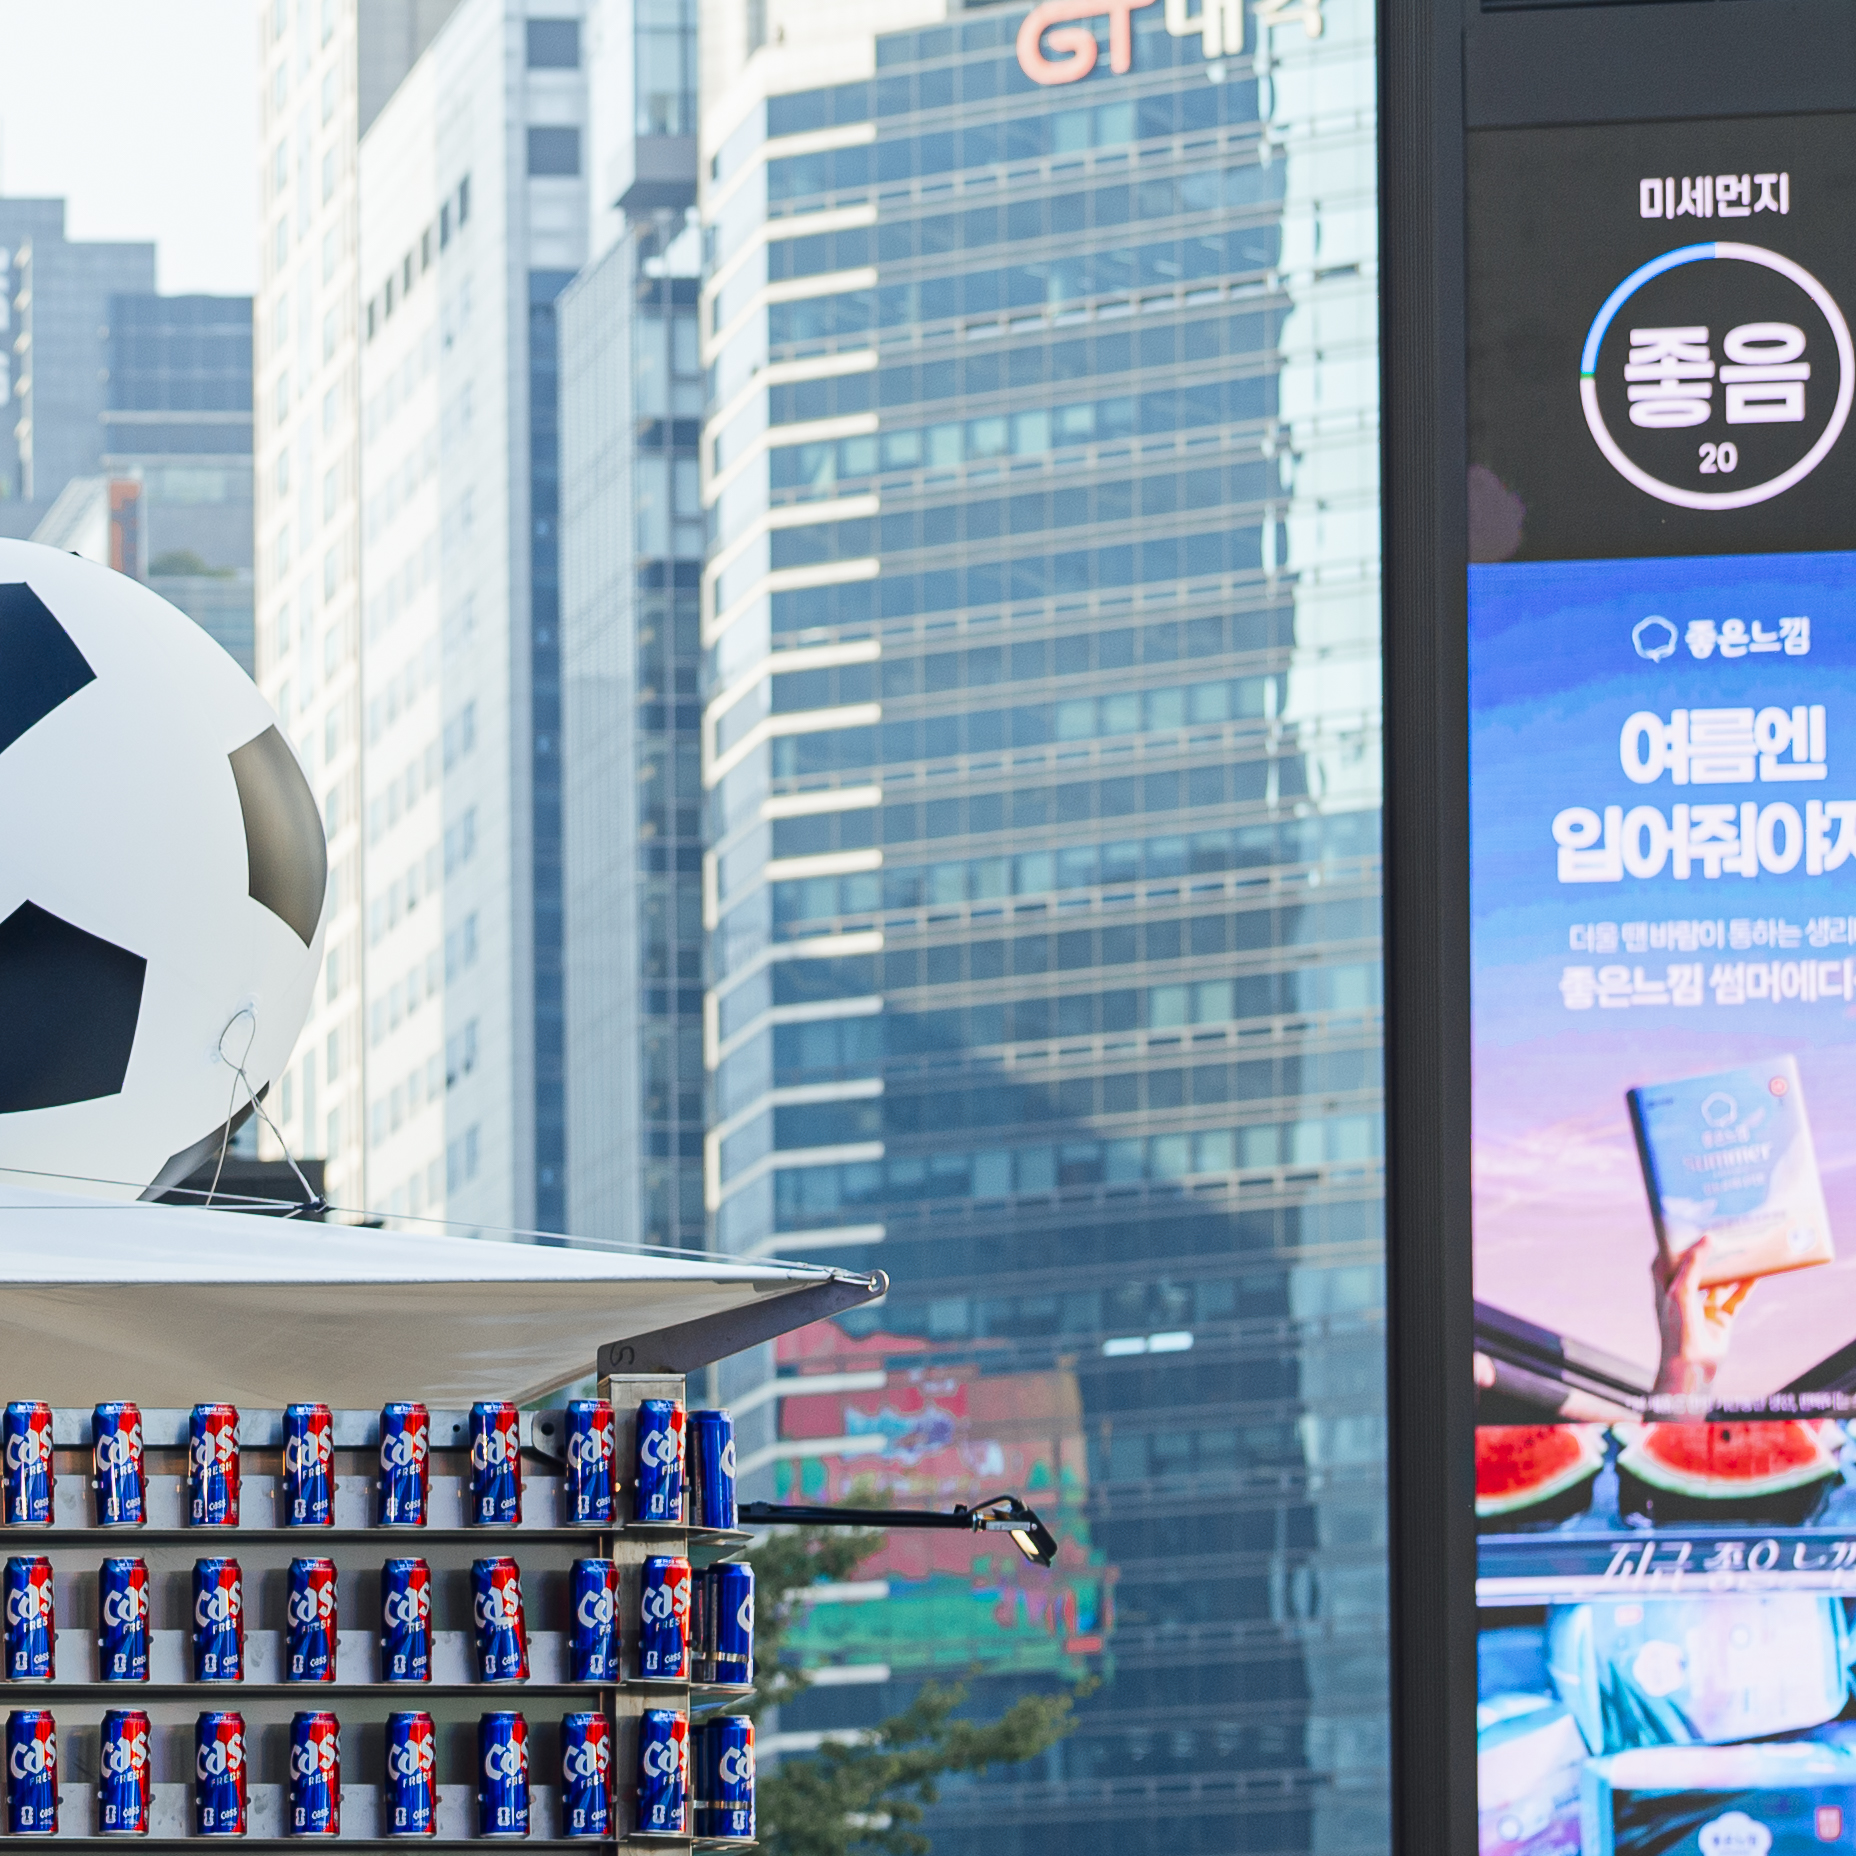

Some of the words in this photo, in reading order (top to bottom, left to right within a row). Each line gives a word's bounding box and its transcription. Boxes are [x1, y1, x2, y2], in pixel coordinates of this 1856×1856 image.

[1640, 172, 1789, 219] 미세먼지
[1624, 322, 1810, 428] 좋음
[1699, 441, 1738, 473] 20
[1684, 616, 1810, 659] 좋은느낌
[1619, 705, 1827, 785] 여름엔
[1559, 962, 1704, 1010] 좋은느낌
[1709, 958, 1856, 1005] 썸머에디
